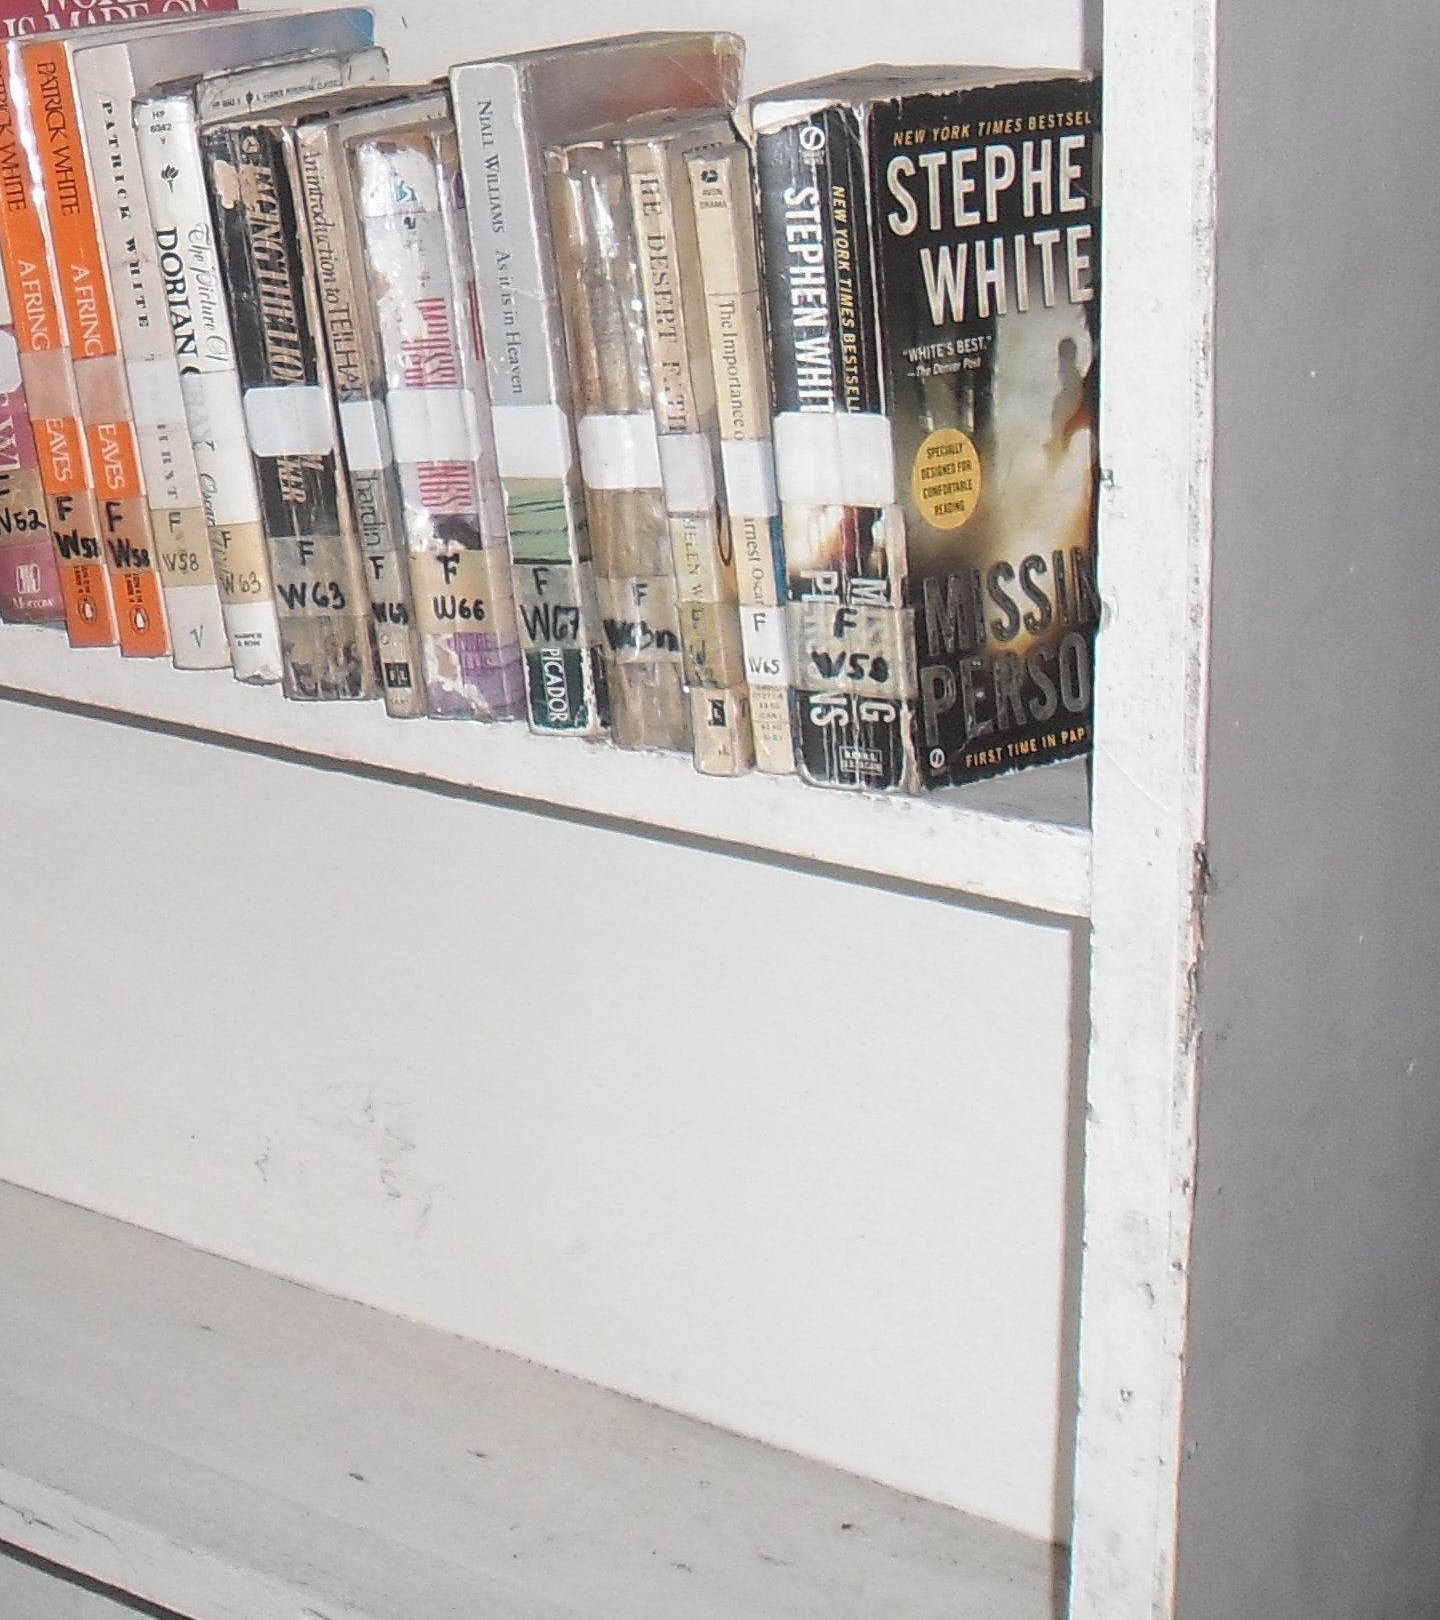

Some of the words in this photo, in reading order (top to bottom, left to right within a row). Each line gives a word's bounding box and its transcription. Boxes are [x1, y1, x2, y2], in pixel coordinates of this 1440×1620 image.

[37, 61, 68, 141] PATRICK
[477, 100, 495, 149] NIALL
[893, 129, 926, 148] NEW
[932, 124, 970, 141] YORK
[977, 117, 1022, 137] TIMES
[1028, 111, 1093, 131] BESTSEL
[52, 146, 80, 216] WHITE
[483, 154, 505, 234] WILLIAMS
[832, 185, 847, 225] NEW
[886, 134, 1086, 237] STEPHE
[103, 101, 131, 221] PATRICK
[125, 238, 150, 329] WHITE
[784, 186, 829, 328] STEPHEN
[834, 228, 851, 271] YORK
[919, 223, 1095, 326] WHITE
[156, 226, 199, 358] DORIAN
[719, 300, 735, 330] The
[839, 277, 855, 328] TIMES
[504, 331, 523, 395] Heaven
[721, 332, 745, 428] Importance
[45, 418, 73, 482] EAVES
[98, 424, 125, 490] EAVES
[921, 462, 956, 481] DESIGNED
[956, 459, 973, 474] FOR
[926, 443, 964, 460] SPECIALLY
[922, 481, 973, 500] COMFORTABLE
[934, 501, 965, 516] READING
[277, 581, 346, 609] W63
[433, 597, 486, 622] W66
[520, 604, 579, 641] W67
[541, 648, 569, 722] PICADOR
[921, 631, 1087, 745] PERSO
[966, 747, 1002, 767] FIRST
[1007, 740, 1038, 759] TIME
[1042, 736, 1057, 749] IN
